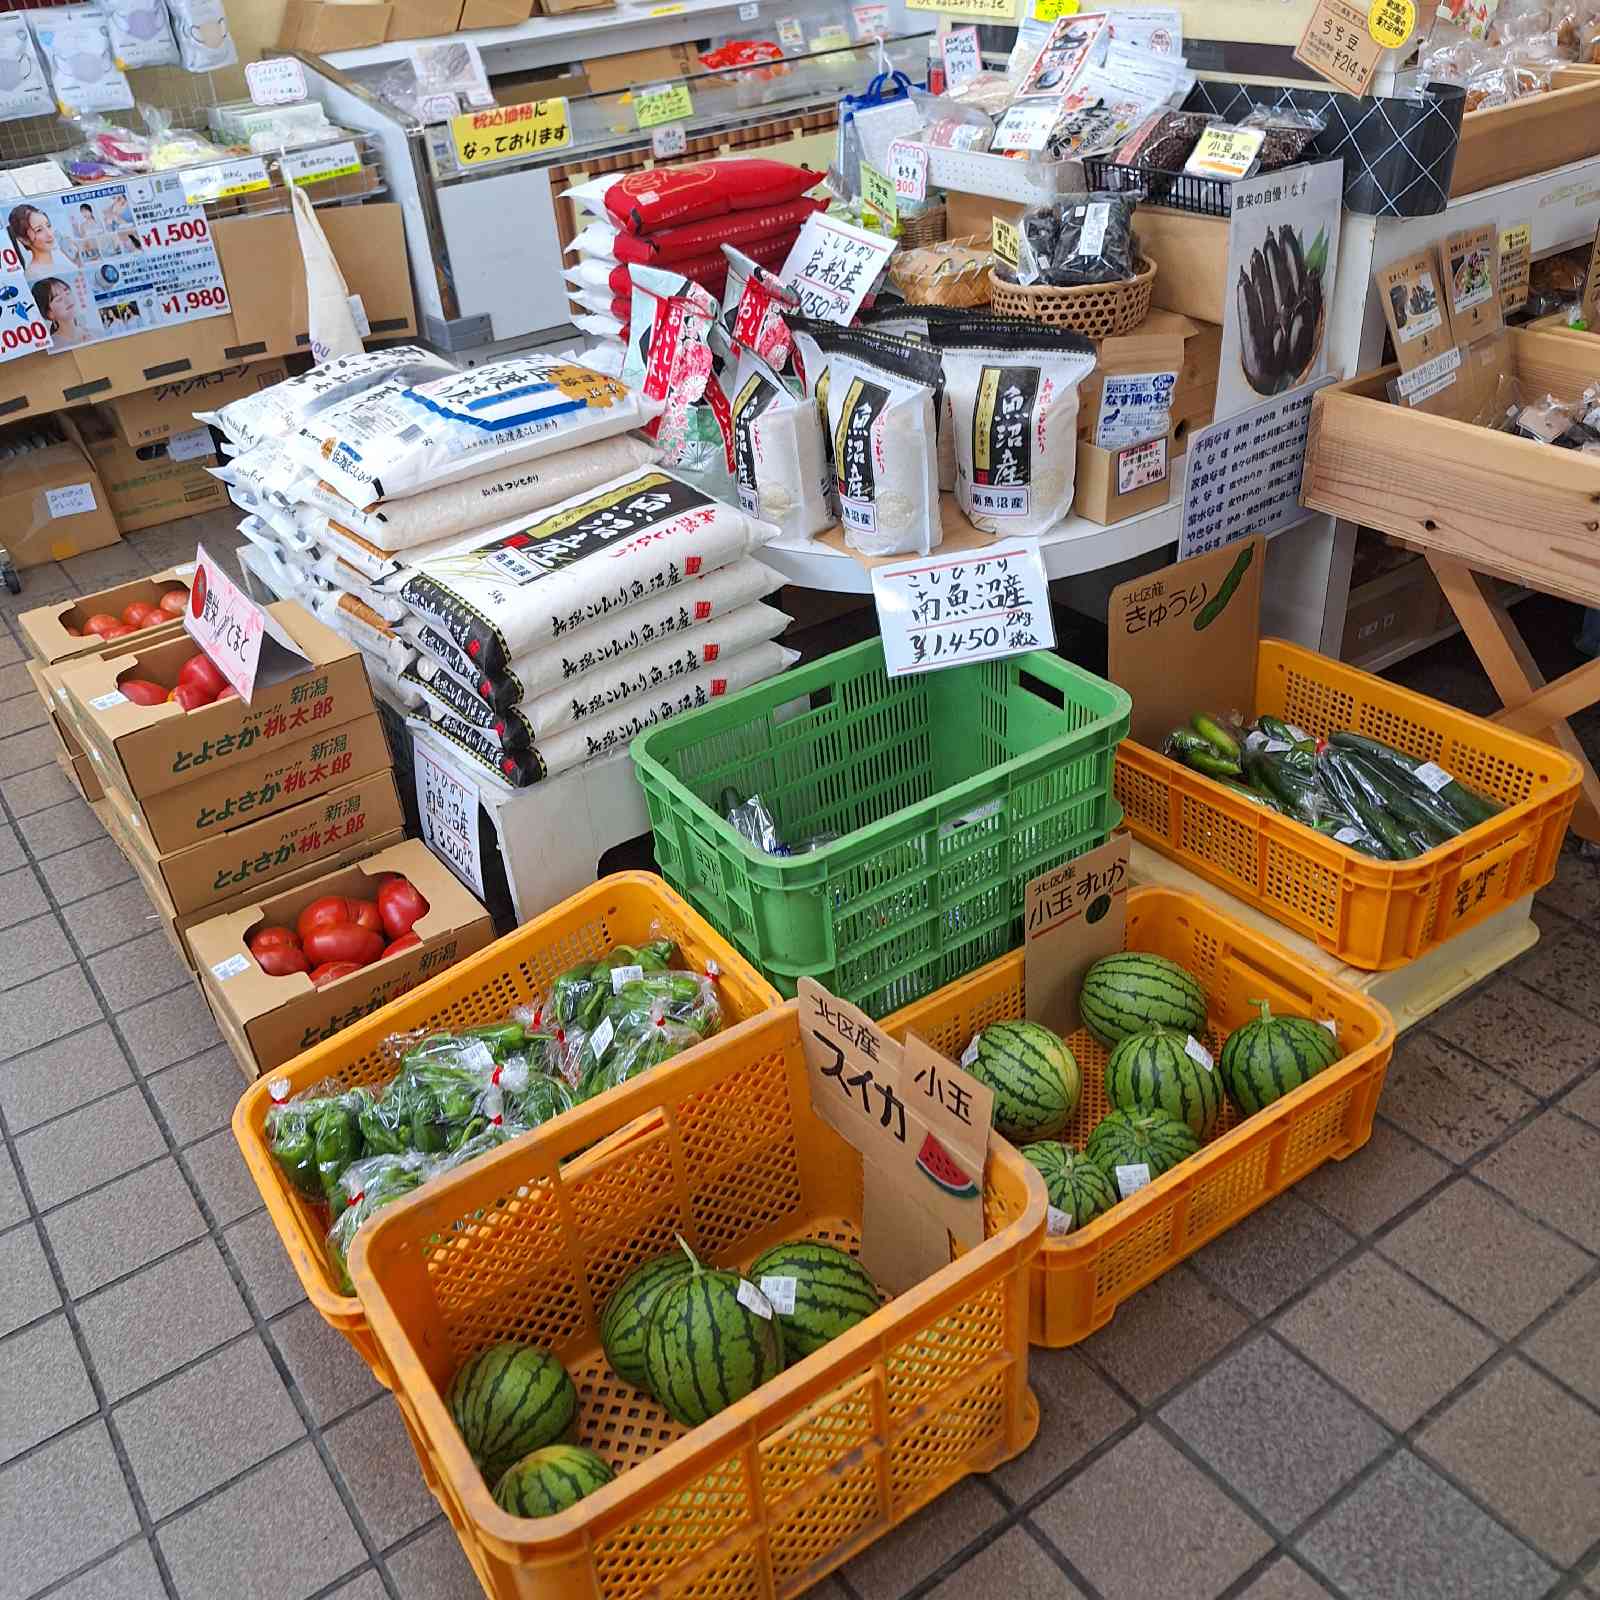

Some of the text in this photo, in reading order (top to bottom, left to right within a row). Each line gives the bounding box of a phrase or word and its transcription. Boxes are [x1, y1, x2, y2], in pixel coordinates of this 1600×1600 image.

[1323, 18, 1360, 51] うち豆
[472, 101, 549, 130] 税込価格に
[463, 125, 567, 158] なっております
[1208, 141, 1234, 153] 小豆
[142, 218, 207, 247] ¥1,500
[823, 232, 875, 261] こしひかり
[801, 248, 863, 294] 岩船産
[162, 287, 226, 315] ¥1,980
[994, 385, 1029, 486] 魚沼産
[847, 401, 873, 502] 魚沼産
[844, 507, 871, 525] 魚沼産
[972, 493, 1024, 509] 南魚沼産
[907, 558, 1009, 588] こしひかり
[911, 574, 1033, 628] 南魚沼産
[1122, 580, 1168, 607] 北区産
[1126, 582, 1208, 634] きゅうり
[1008, 630, 1041, 648] 税込
[290, 675, 329, 705] 新潟
[309, 733, 348, 762] 新潟
[324, 794, 361, 823] 新潟
[1029, 857, 1128, 930] 小玉 すいか
[1034, 865, 1076, 896] 北区産
[417, 940, 458, 972] 新潟
[810, 993, 881, 1063] 北区産
[812, 1029, 906, 1143] スイカ
[914, 1065, 973, 1126] 小玉
